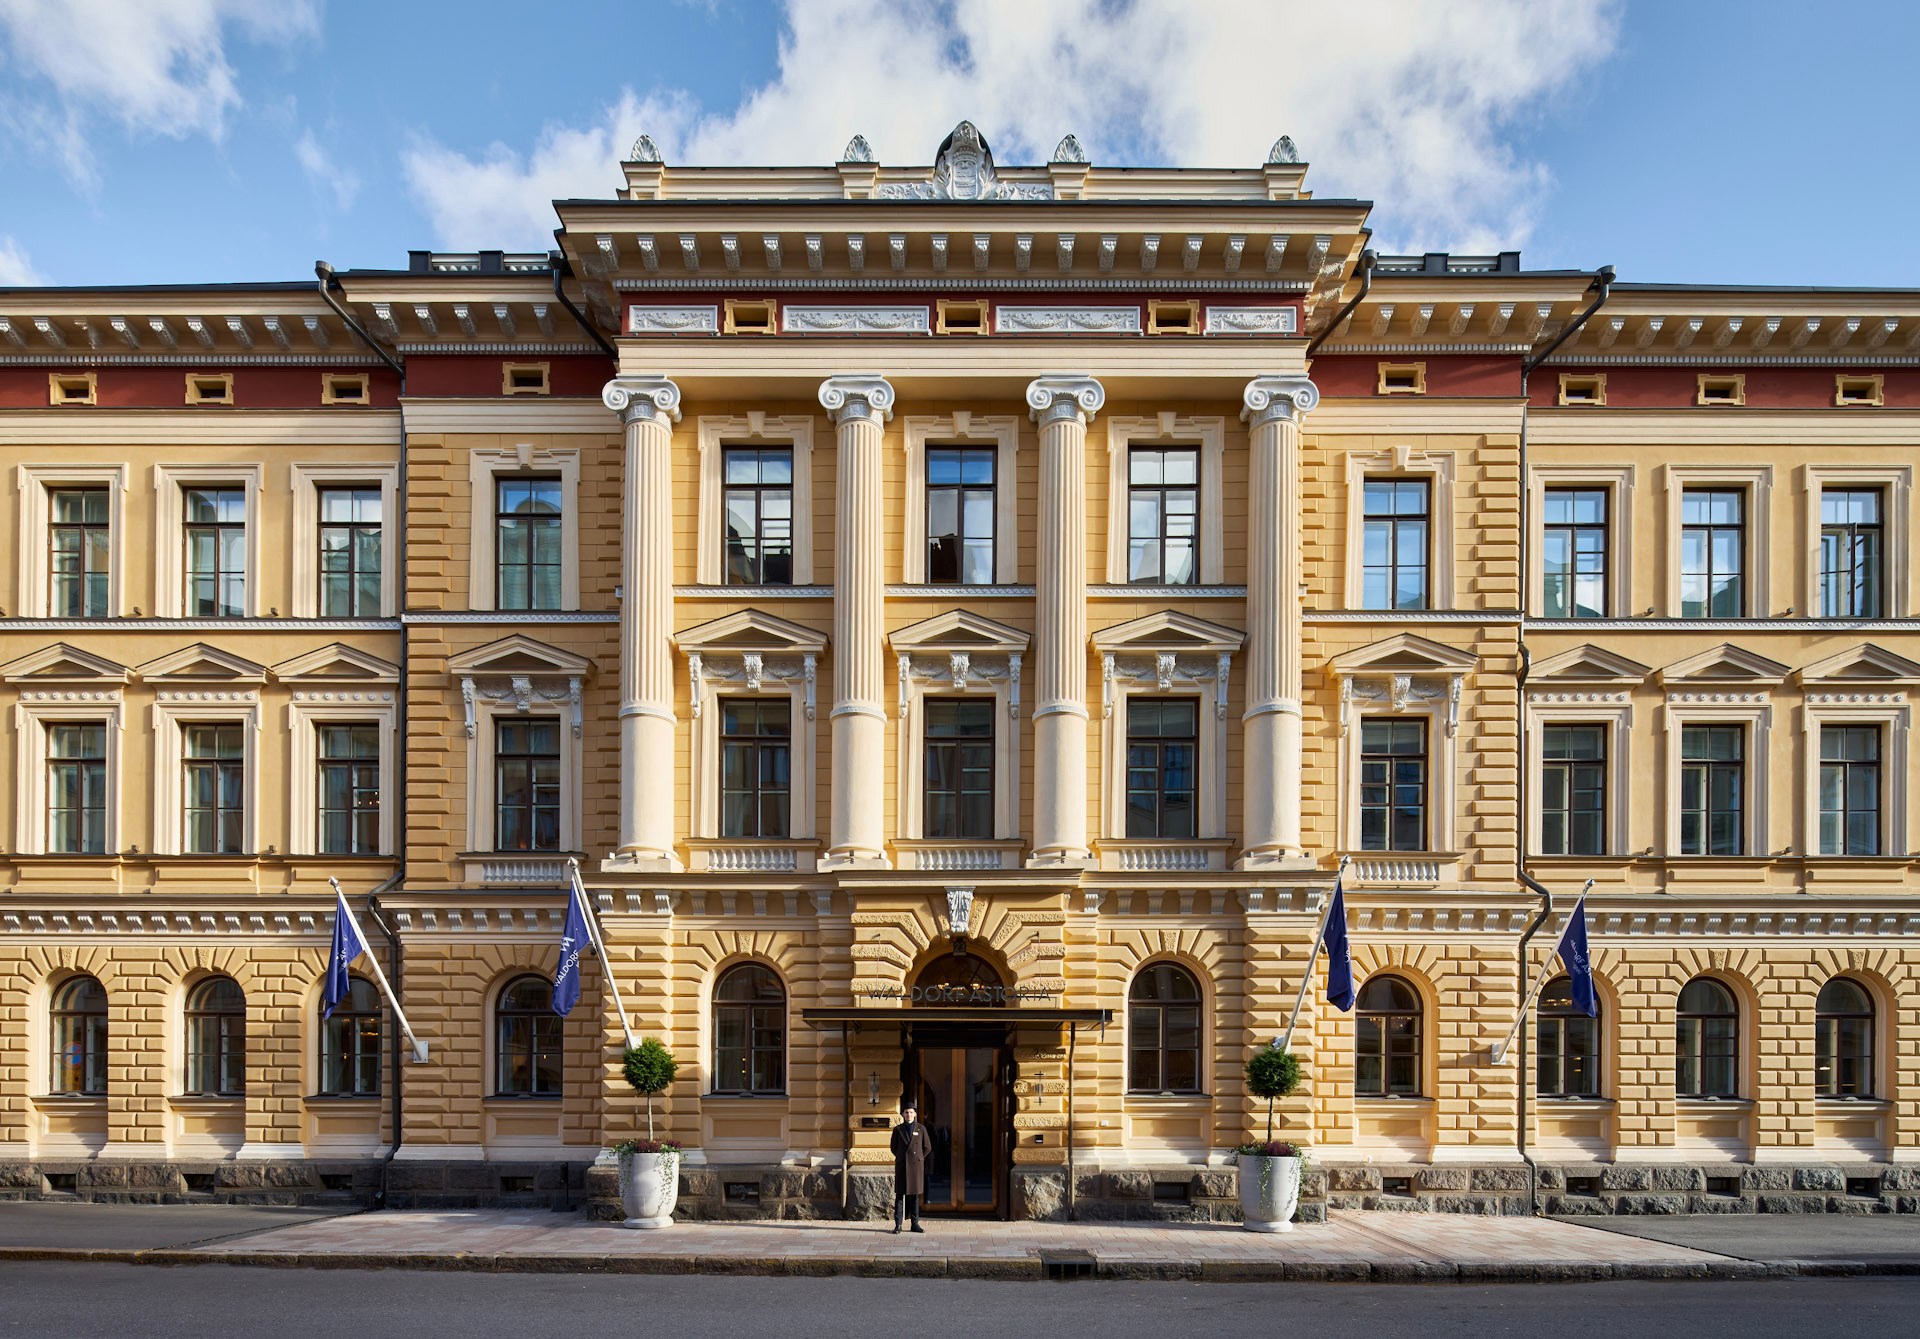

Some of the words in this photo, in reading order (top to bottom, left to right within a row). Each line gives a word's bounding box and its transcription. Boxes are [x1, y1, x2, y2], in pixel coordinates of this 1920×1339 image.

[554, 950, 579, 987] WALDORF
[866, 984, 965, 1002] WALDORF
[969, 984, 1051, 1002] ASTORIA
